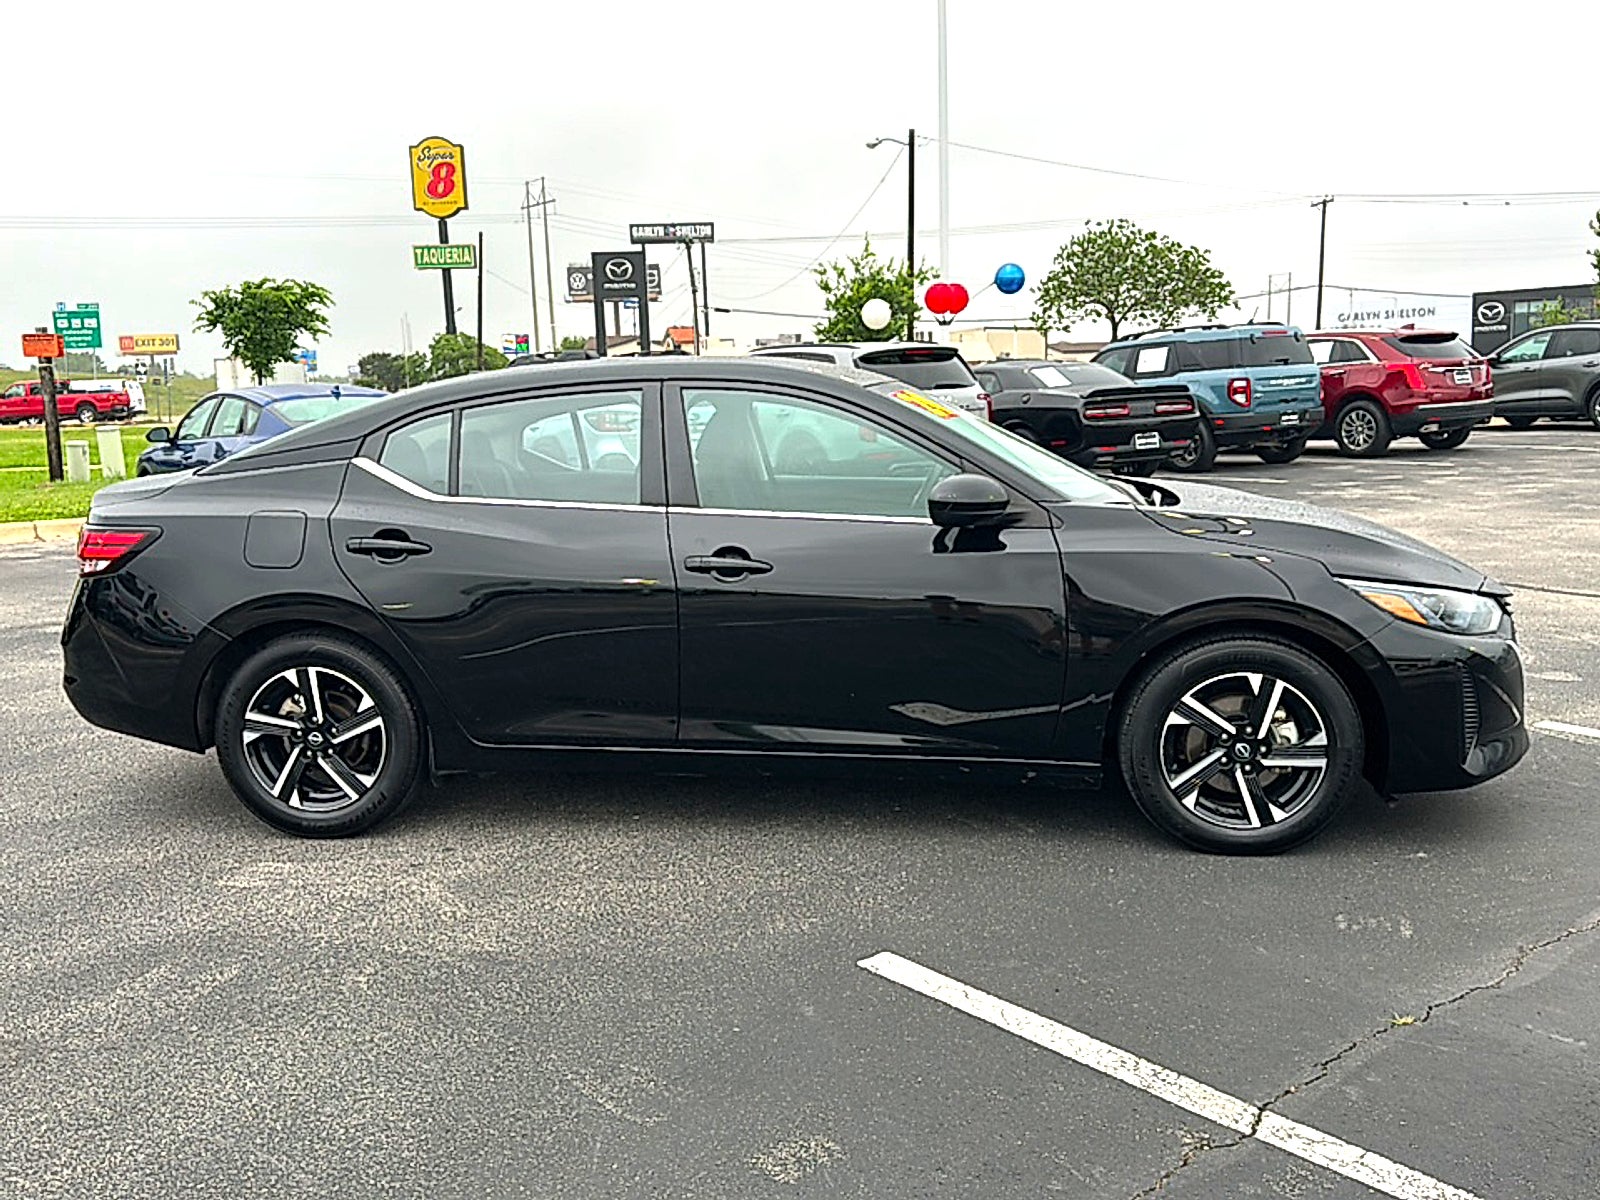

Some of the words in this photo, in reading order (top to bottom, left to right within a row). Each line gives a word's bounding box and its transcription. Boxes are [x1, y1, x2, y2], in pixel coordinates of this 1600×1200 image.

[416, 145, 455, 168] Super
[426, 162, 456, 199] 8
[415, 247, 471, 264] TAQUERIA
